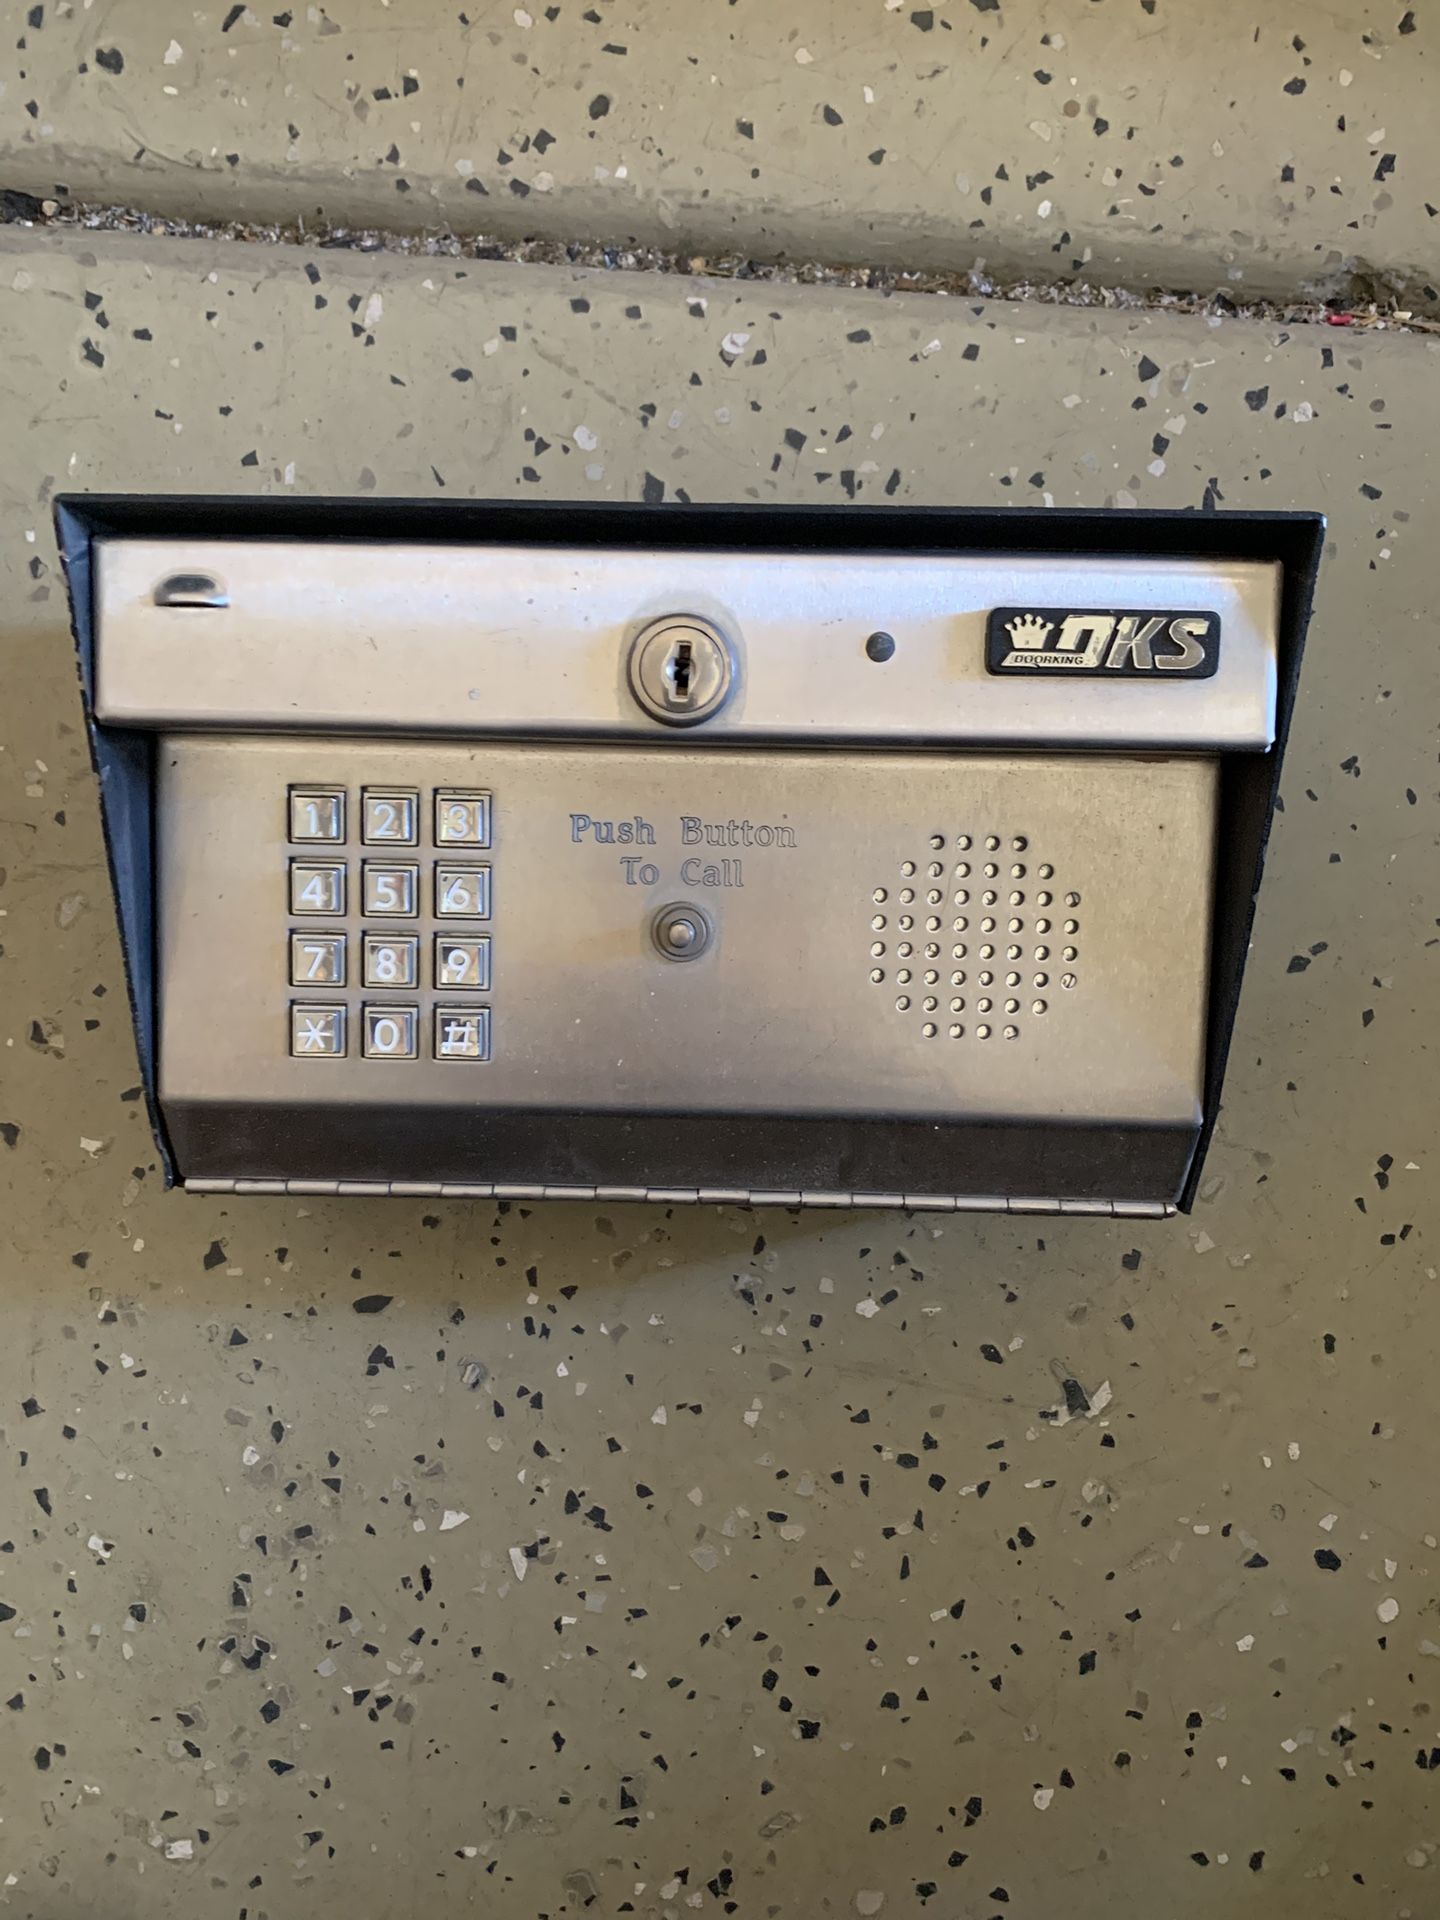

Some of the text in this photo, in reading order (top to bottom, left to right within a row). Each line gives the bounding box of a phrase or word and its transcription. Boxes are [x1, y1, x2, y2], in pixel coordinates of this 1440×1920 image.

[1056, 614, 1209, 669] DKS
[1013, 654, 1084, 666] DOORKING
[306, 803, 470, 839] 1 2 3
[569, 813, 798, 848] Push Button
[619, 856, 745, 888] To Call
[302, 875, 470, 909] 4 5 6
[303, 946, 470, 983] 7 8 9
[375, 1019, 398, 1049] 0
[442, 1021, 475, 1051] #
